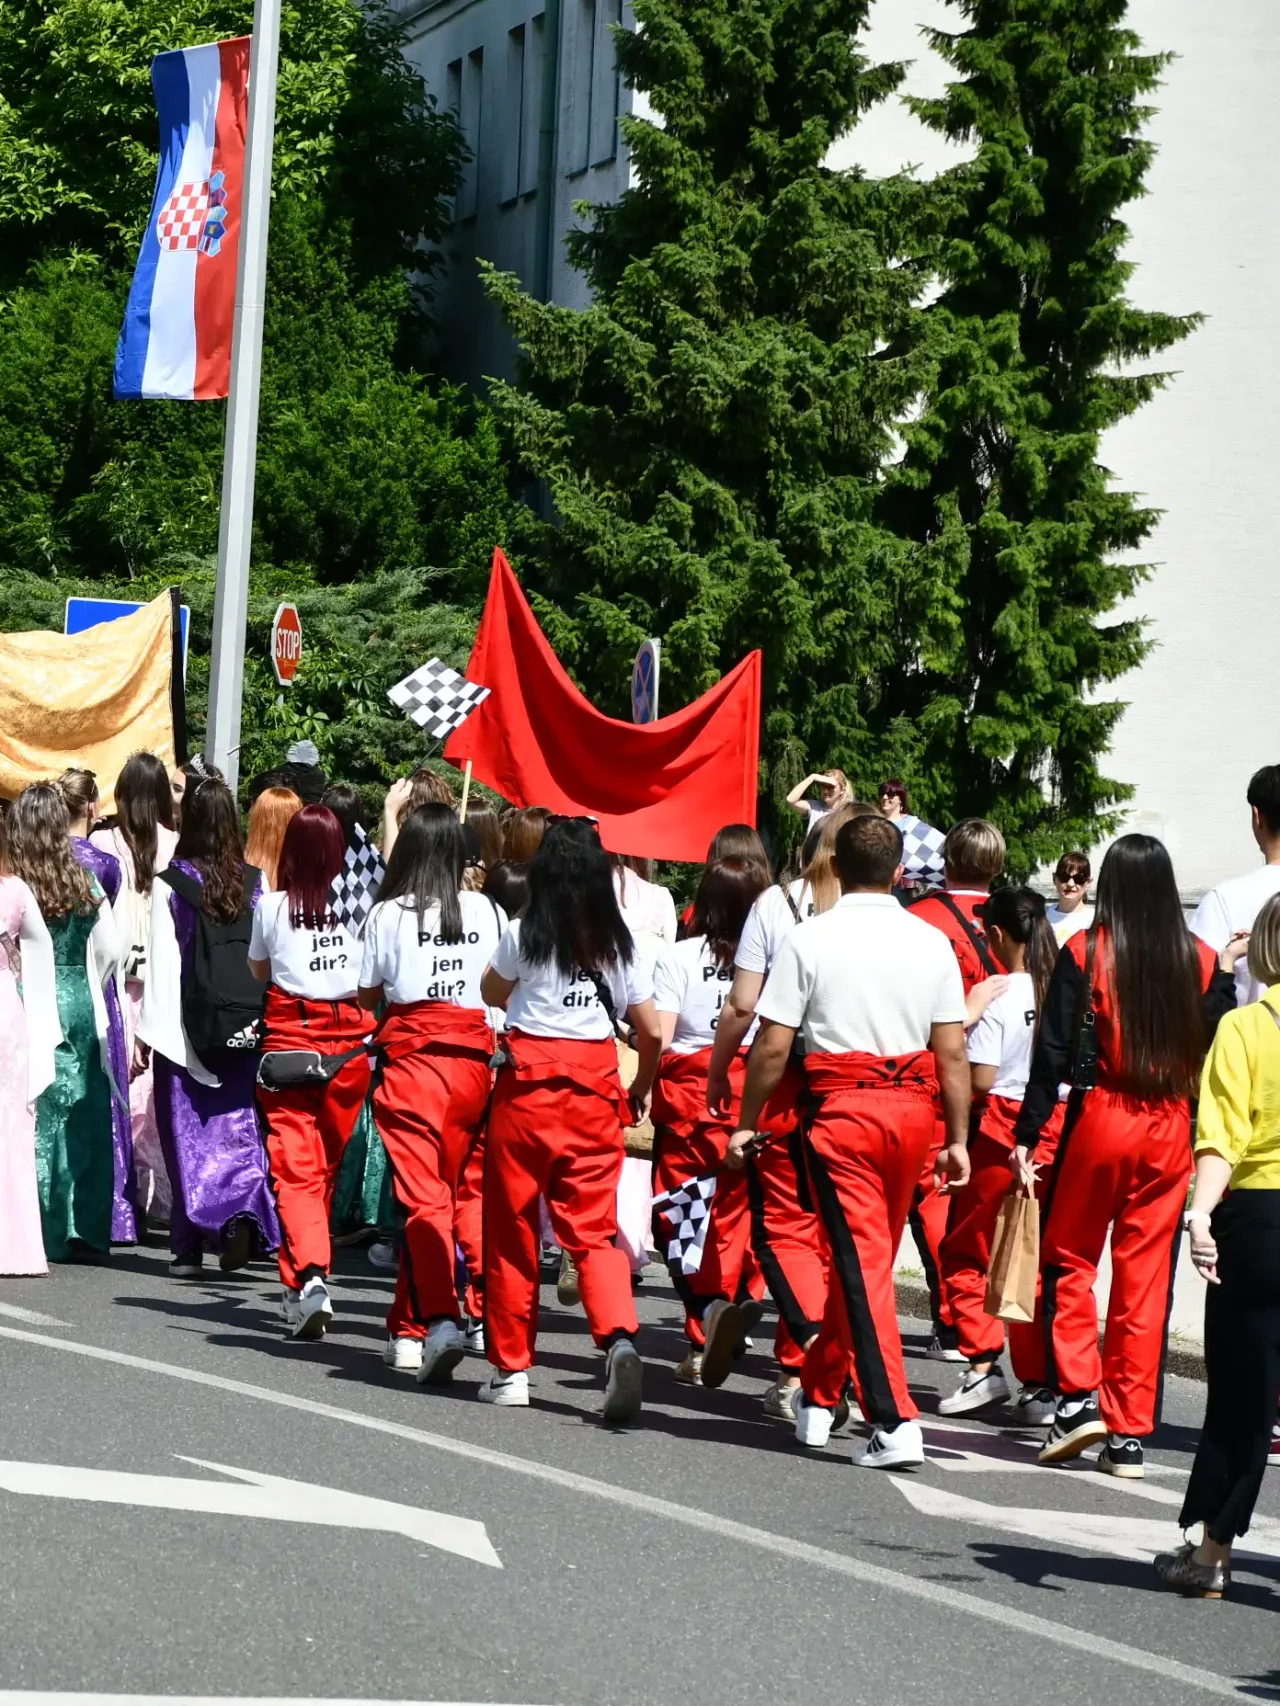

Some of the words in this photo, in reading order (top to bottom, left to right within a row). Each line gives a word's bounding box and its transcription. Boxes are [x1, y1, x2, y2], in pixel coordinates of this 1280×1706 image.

[276, 627, 300, 660] STOP
[312, 933, 344, 953] jen
[309, 953, 348, 972] đir?
[431, 955, 463, 977] jen
[569, 966, 603, 986] je
[426, 980, 466, 998] đir?
